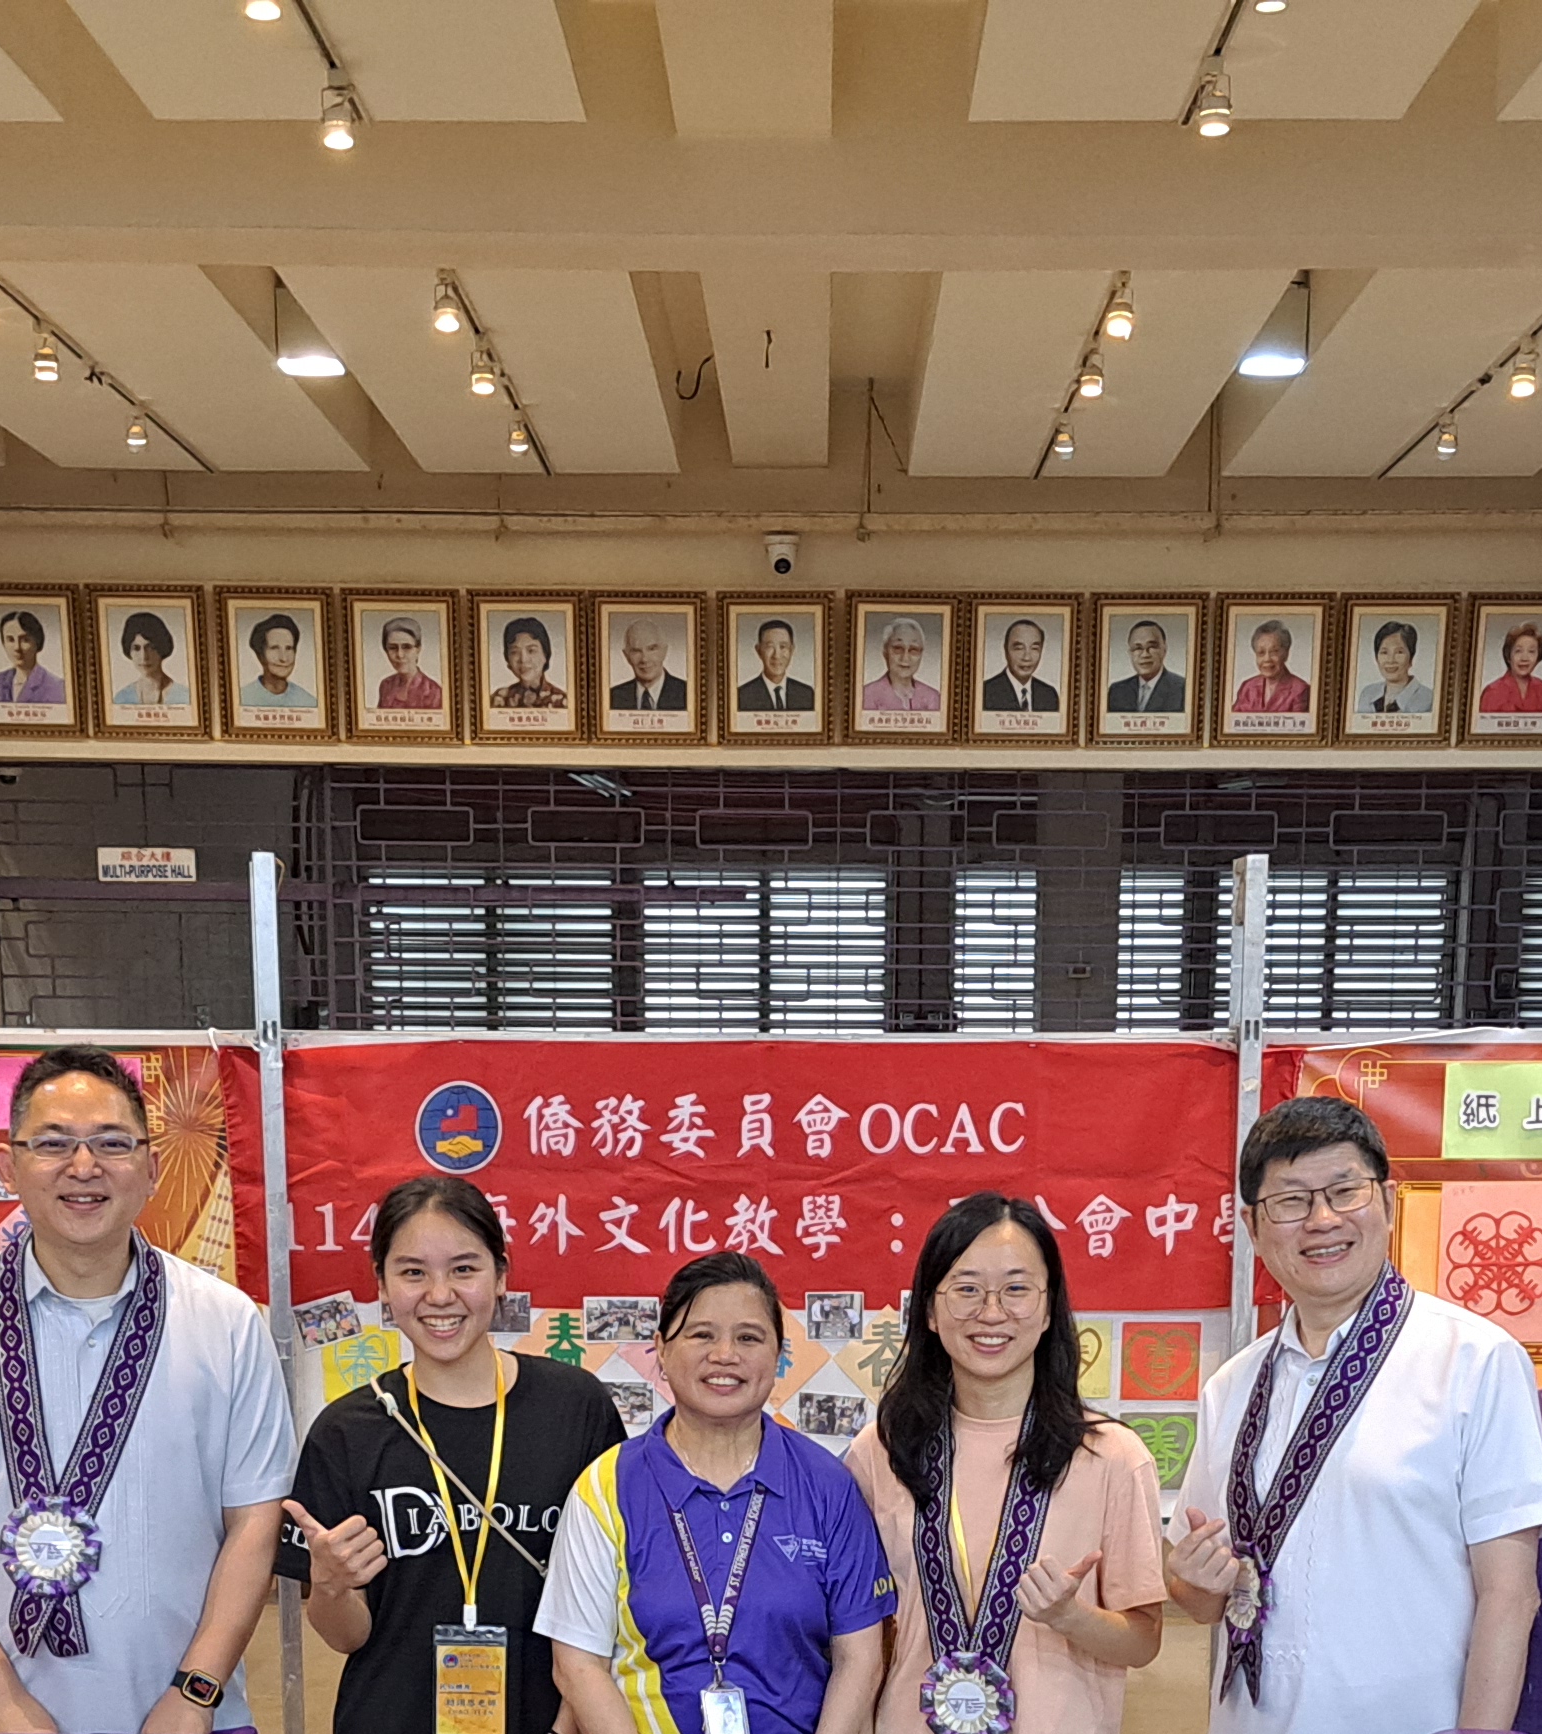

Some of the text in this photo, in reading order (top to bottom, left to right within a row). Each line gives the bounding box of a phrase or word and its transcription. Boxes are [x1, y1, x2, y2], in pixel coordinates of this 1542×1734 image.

[102, 864, 194, 879] MULTI-PURPOSE HALL
[672, 1511, 703, 1584] Administrator
[732, 1537, 751, 1575] STEPHEN'S
[747, 1492, 764, 1520] SCHOOL
